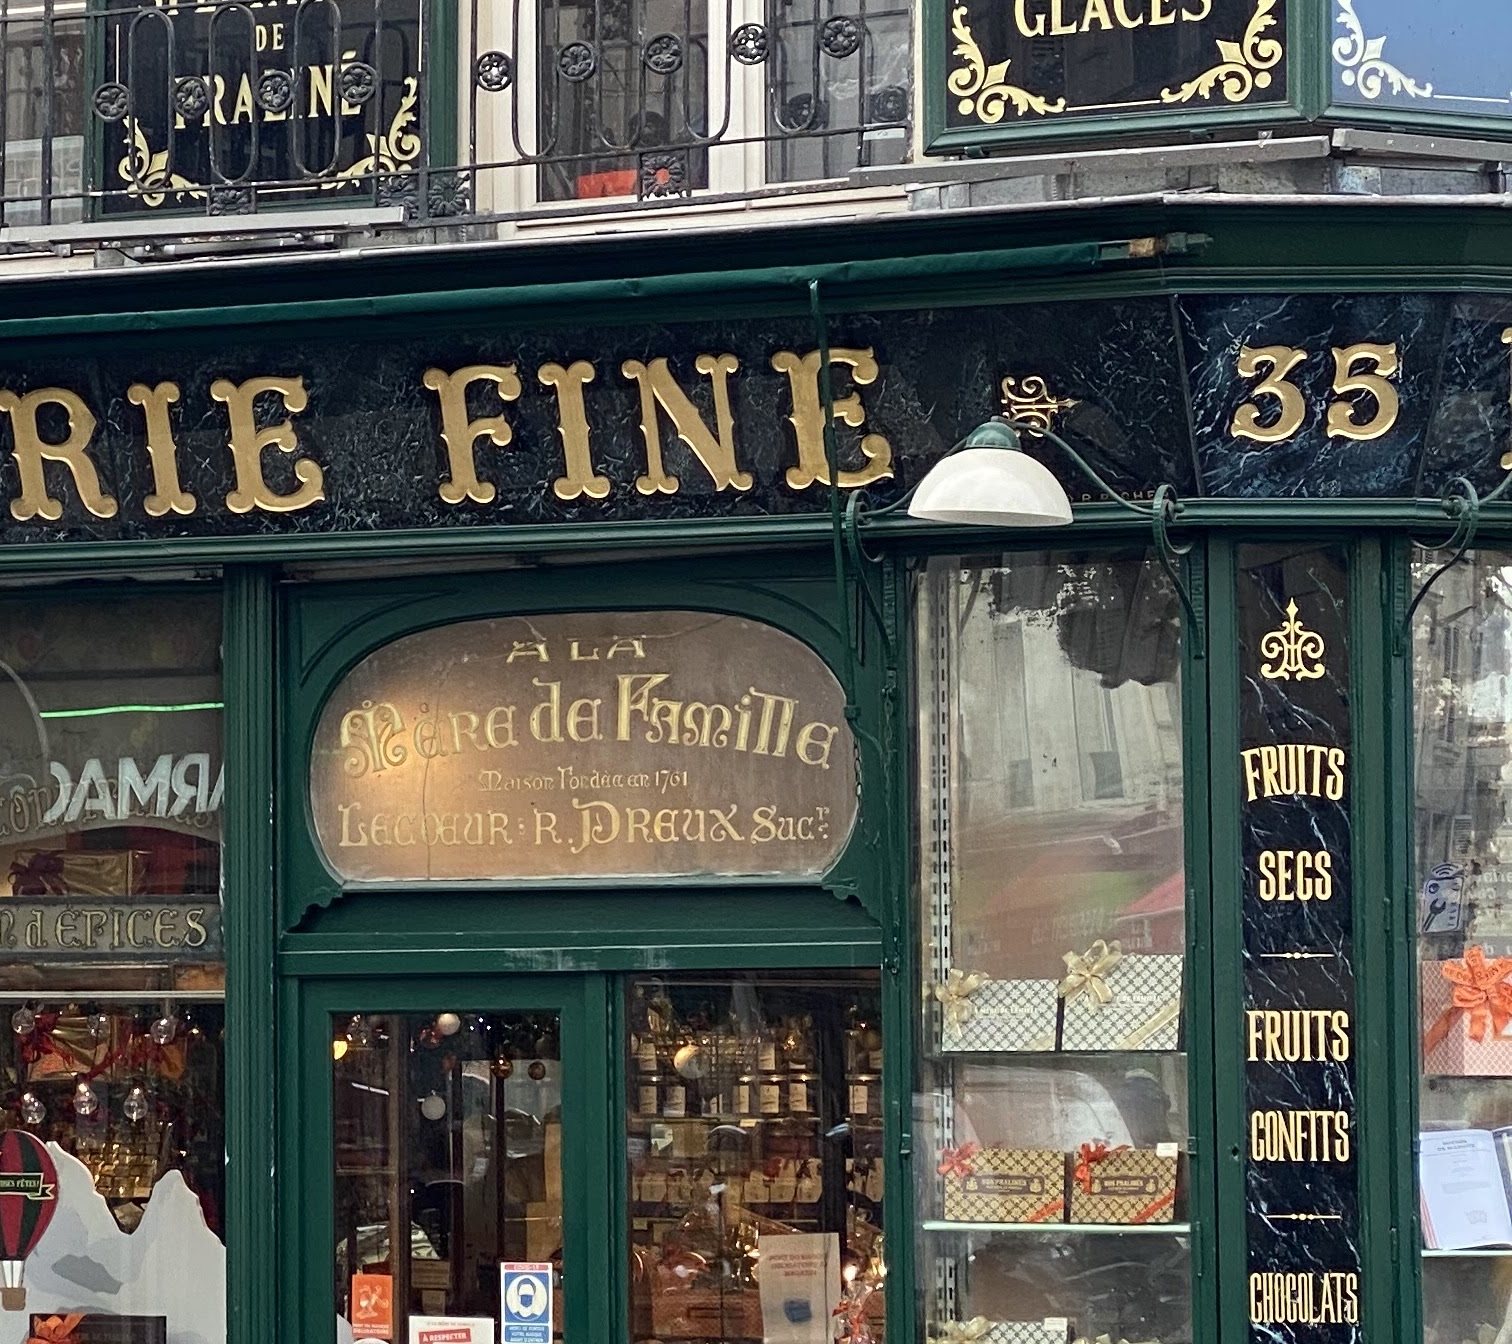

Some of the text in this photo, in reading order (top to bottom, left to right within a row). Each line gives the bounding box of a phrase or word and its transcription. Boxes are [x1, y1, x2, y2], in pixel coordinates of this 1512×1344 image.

[255, 23, 285, 53] DE
[1229, 342, 1400, 442] 35
[423, 346, 893, 505] FINE
[506, 634, 647, 664] A LA
[530, 677, 603, 743] de
[654, 771, 688, 794] 1761
[1241, 744, 1345, 803] FRUITS
[1246, 1009, 1349, 1062] FRUITS
[1251, 1110, 1349, 1162] CONFITS
[1249, 1272, 1359, 1324] CHOCOLATS
[429, 1331, 467, 1342] RESPECTER
